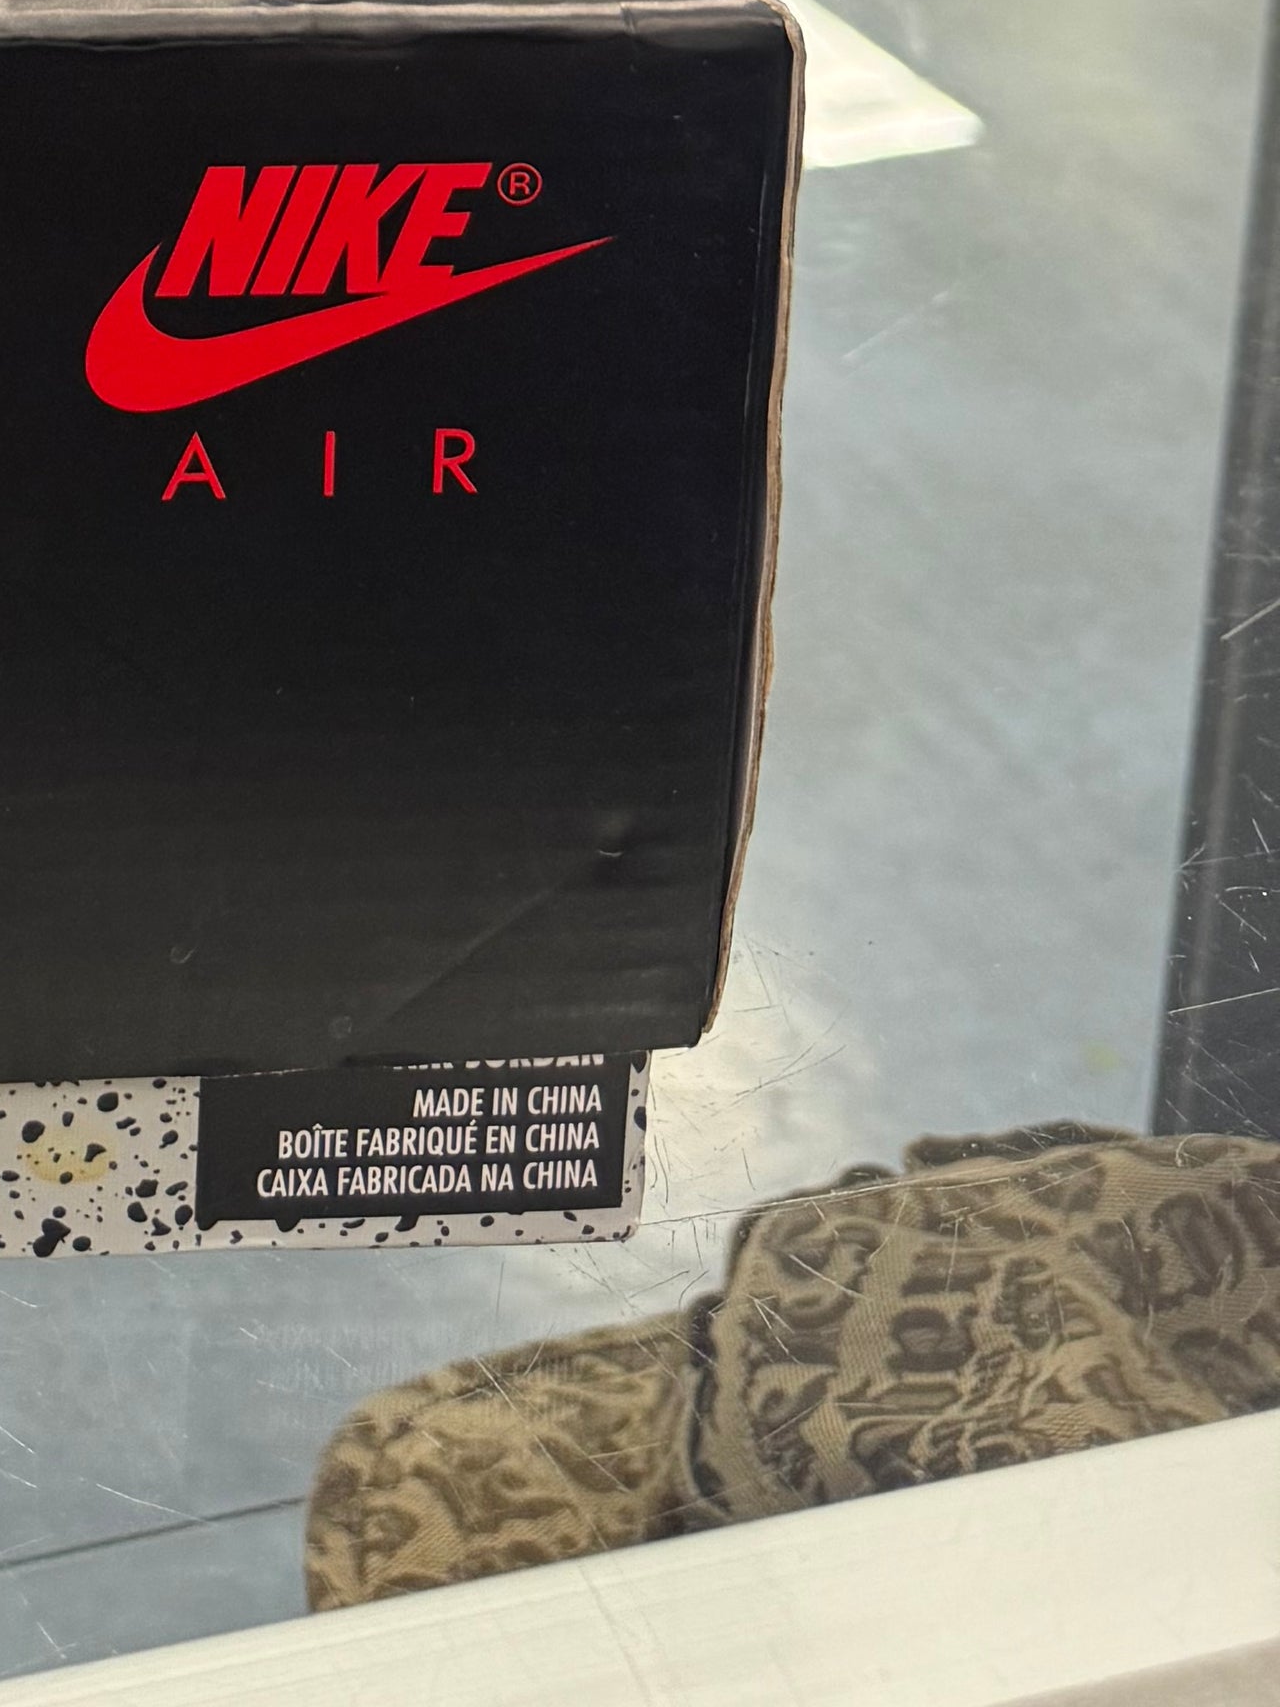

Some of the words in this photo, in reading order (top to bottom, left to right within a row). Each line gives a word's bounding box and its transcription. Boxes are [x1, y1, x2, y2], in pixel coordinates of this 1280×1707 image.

[154, 162, 493, 297] NIKE
[161, 428, 478, 500] AIR
[412, 1087, 484, 1118] MADE
[492, 1087, 518, 1116] IN
[527, 1084, 602, 1116] CHINA
[278, 1123, 348, 1160] BOÎTE
[355, 1119, 477, 1158] FABRIQUÉ
[486, 1128, 516, 1154] EN
[525, 1123, 600, 1152] CHINA
[256, 1167, 329, 1198] CAIXA
[336, 1163, 472, 1197] FABRICADA
[481, 1164, 514, 1192] NA
[522, 1159, 598, 1190] CHINA
